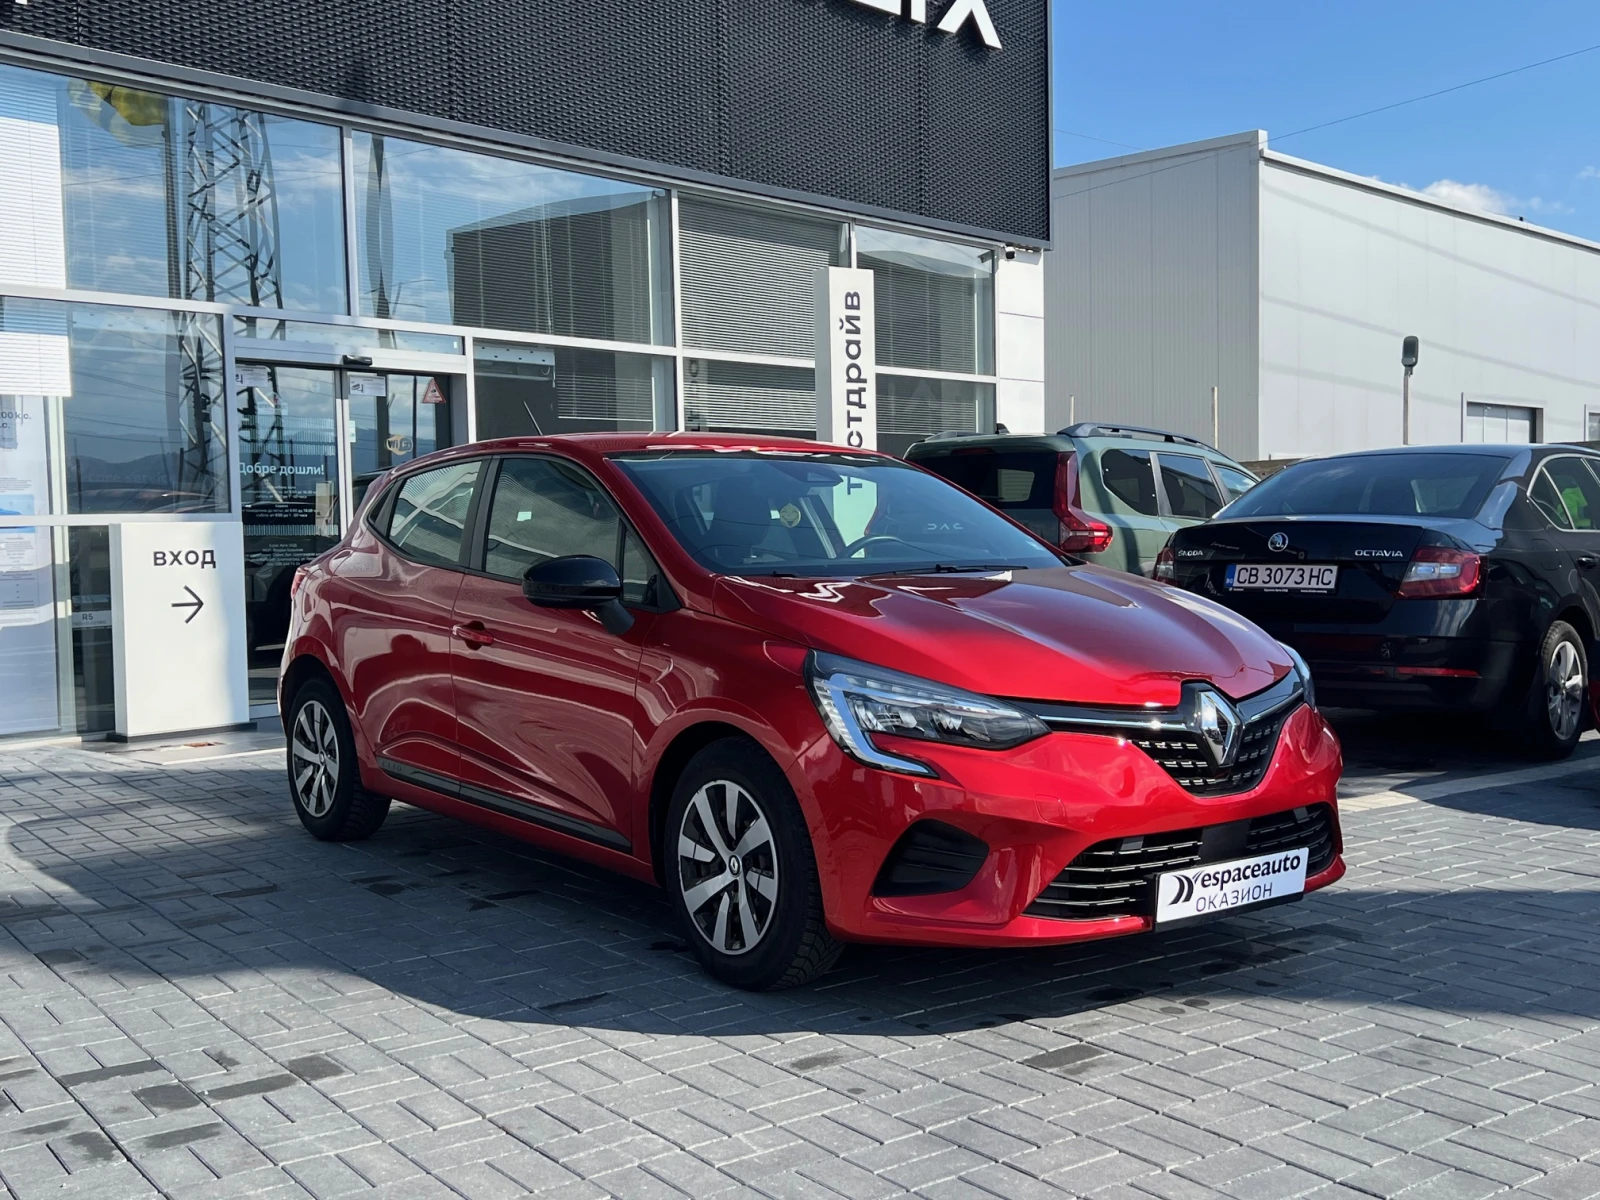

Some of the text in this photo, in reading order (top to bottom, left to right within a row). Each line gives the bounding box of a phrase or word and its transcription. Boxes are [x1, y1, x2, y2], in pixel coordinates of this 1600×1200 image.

[239, 462, 325, 476] Добре дошли!
[1354, 549, 1404, 558] OCTAVIA
[1236, 567, 1333, 586] CB 3073 HC
[1200, 853, 1301, 891] espaceauto
[1195, 882, 1273, 913] ОКАЗИОН
